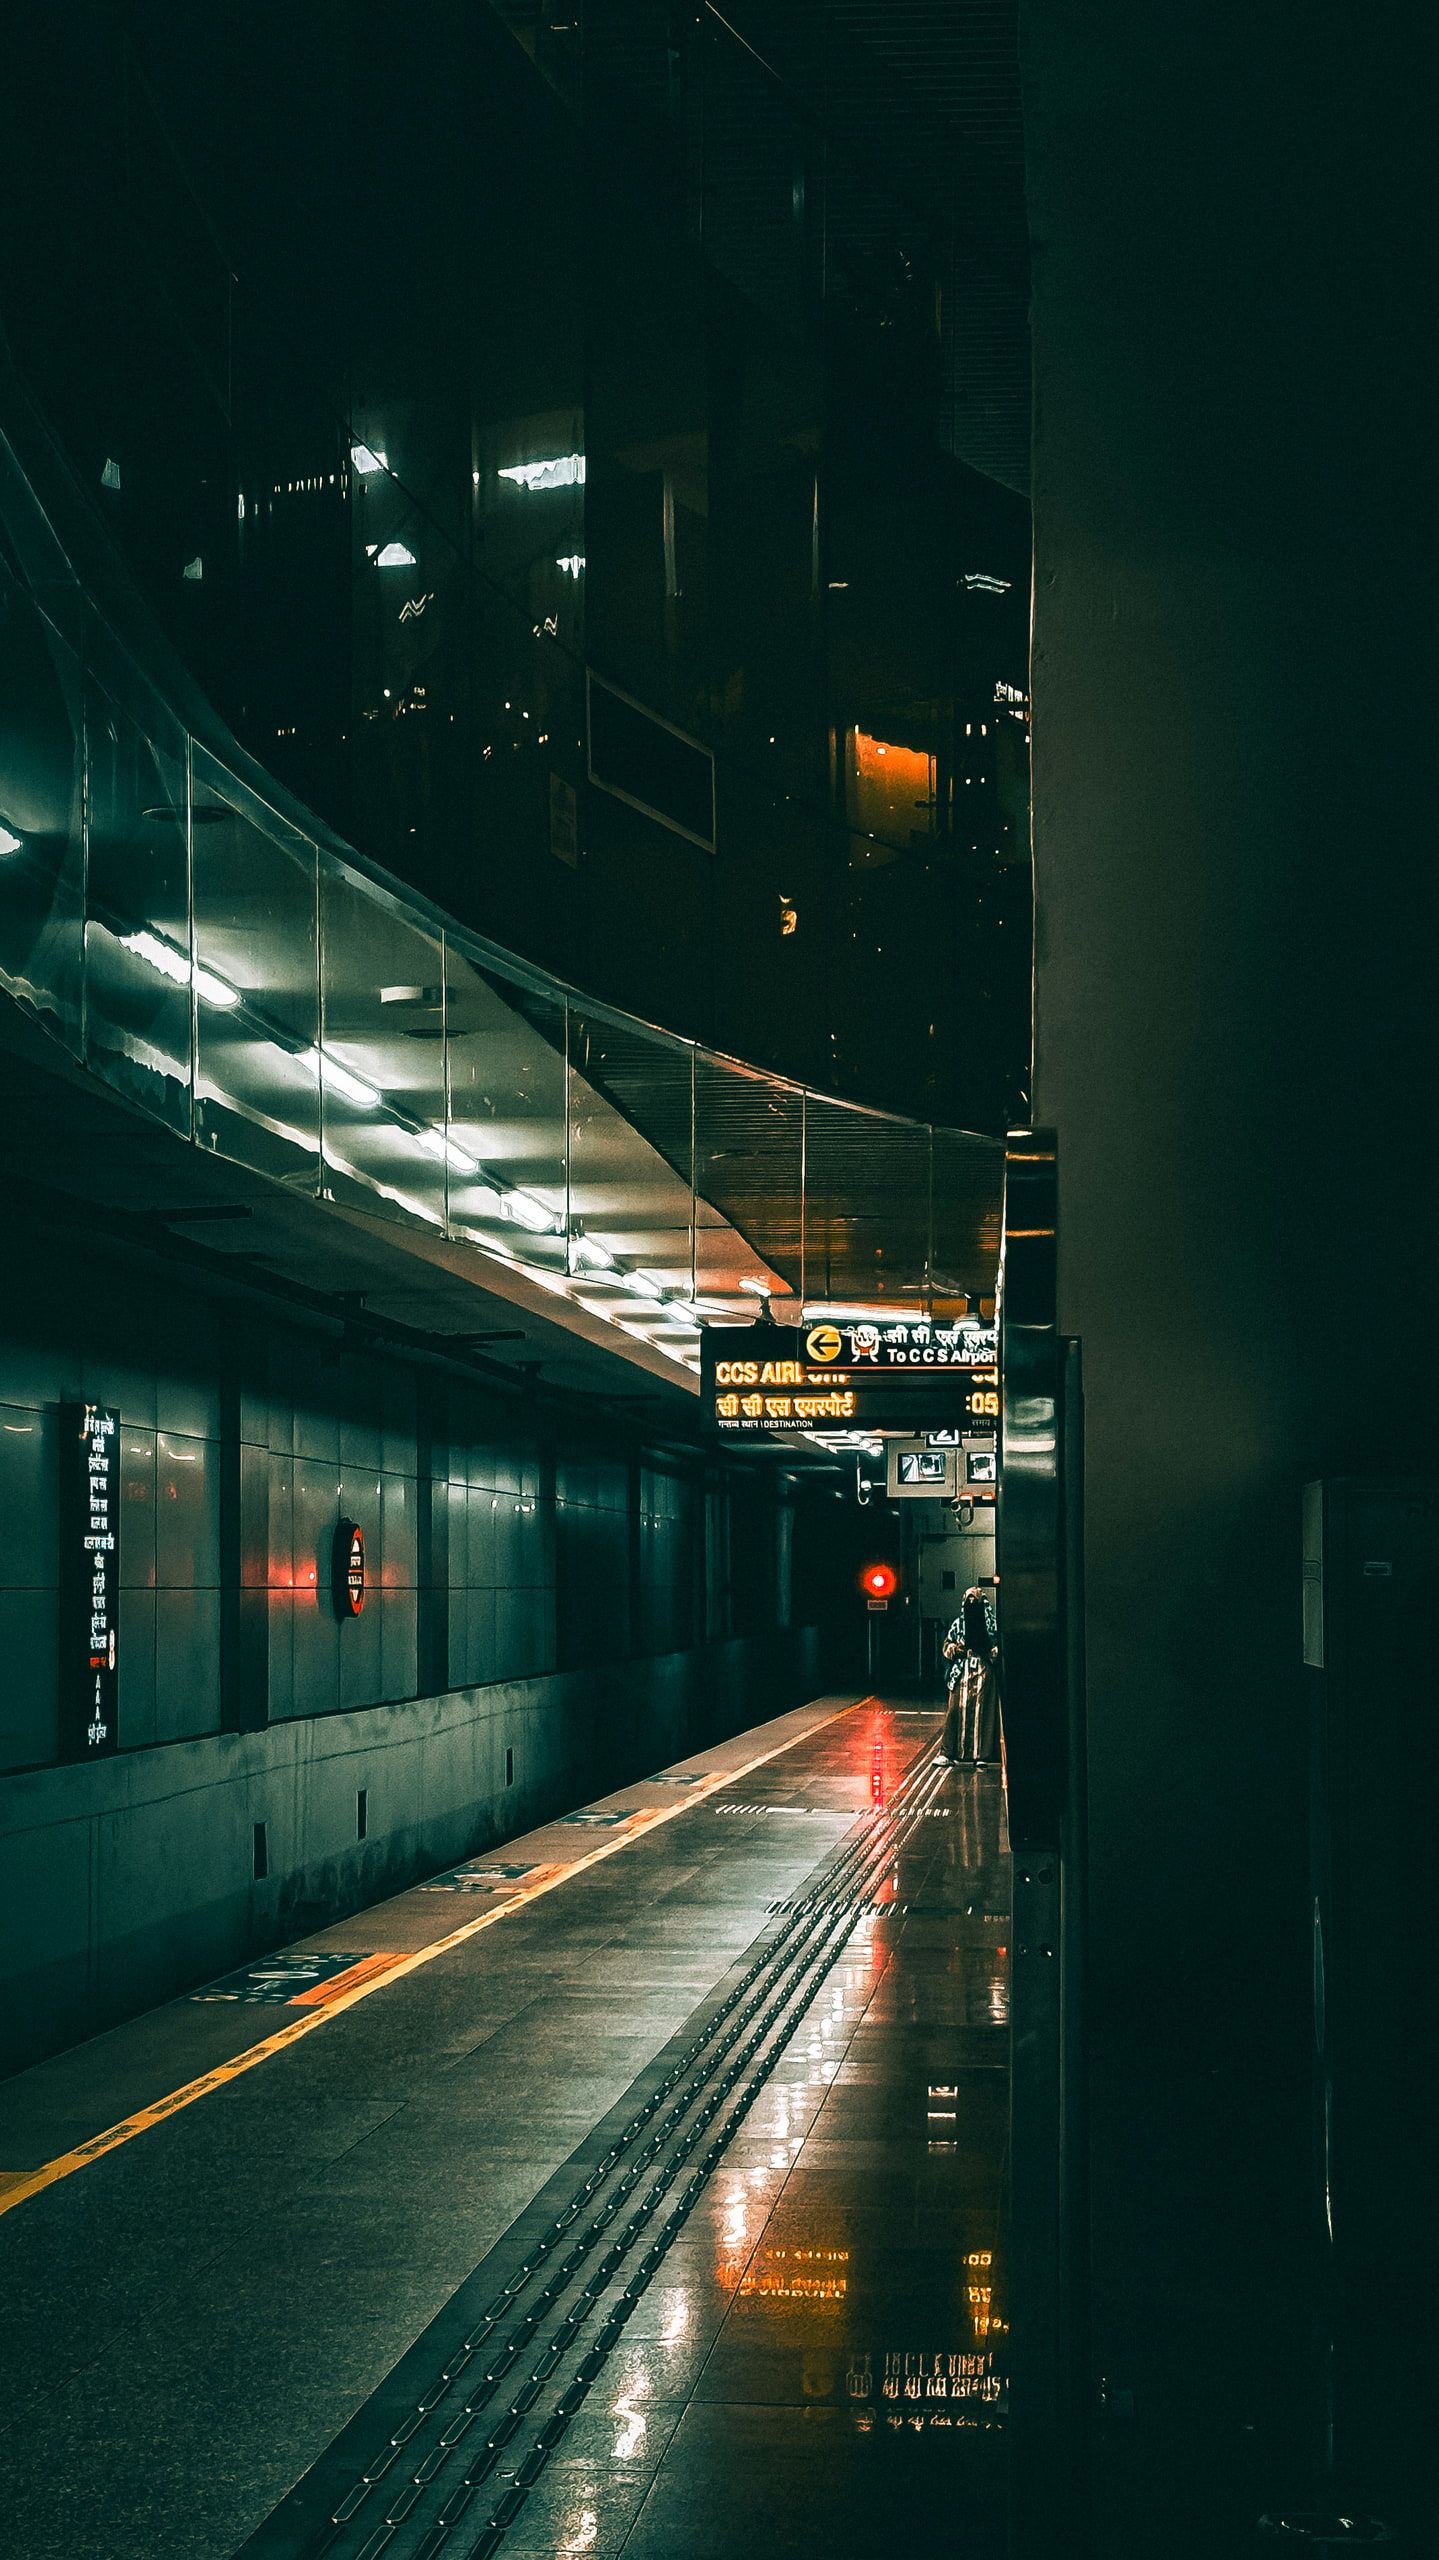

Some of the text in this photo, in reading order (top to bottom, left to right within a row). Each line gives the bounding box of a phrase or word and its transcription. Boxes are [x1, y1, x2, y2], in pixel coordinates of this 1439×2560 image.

[887, 1349, 908, 1363] To
[950, 1348, 997, 1365] Airpor
[716, 1362, 758, 1384] CCS
[716, 1393, 739, 1417] सी
[741, 1393, 763, 1417] सी
[765, 1397, 791, 1417] एस
[764, 1420, 813, 1429] DESTINATION
